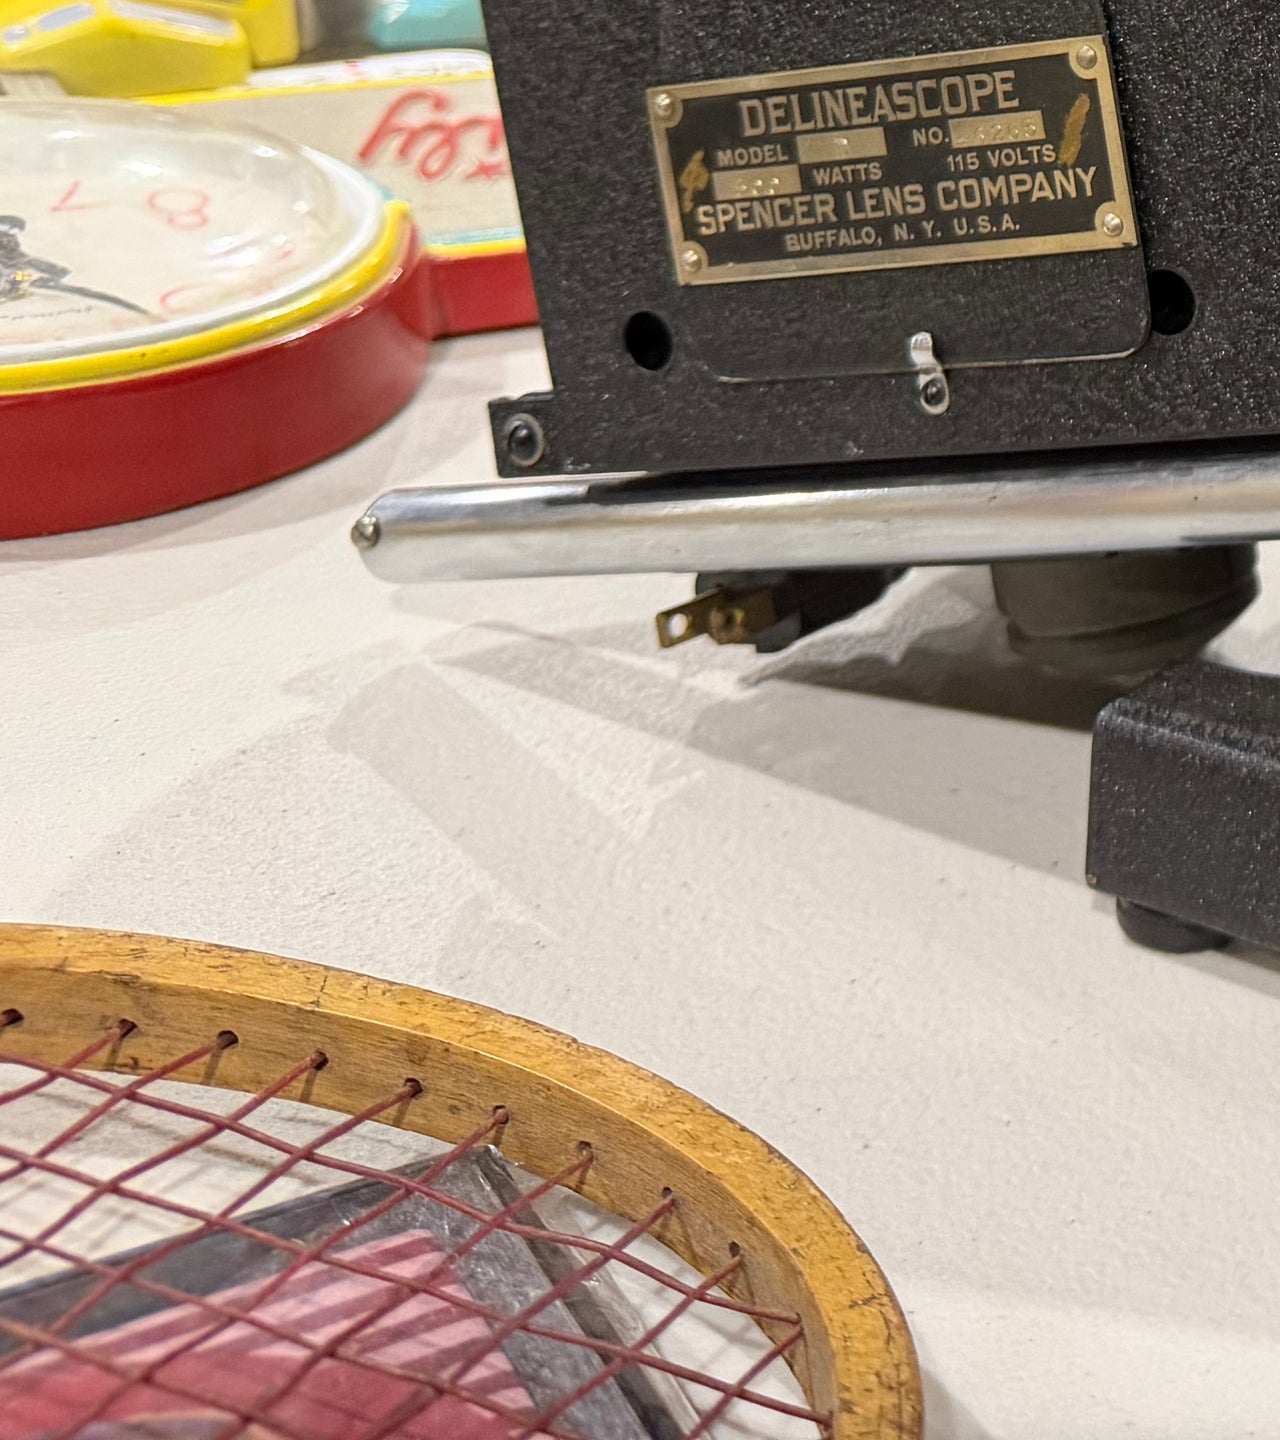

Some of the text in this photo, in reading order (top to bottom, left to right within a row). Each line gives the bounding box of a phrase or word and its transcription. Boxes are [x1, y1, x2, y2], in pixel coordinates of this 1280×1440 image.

[738, 69, 1020, 138] DELINEASCOPE
[912, 126, 950, 147] NO.
[716, 143, 789, 168] MODEL
[946, 143, 1057, 173] 115 VOLTS
[812, 161, 883, 186] WATTS
[698, 165, 1098, 237] SPENCER LENS COMPANY
[785, 225, 884, 252] BUFFALO,
